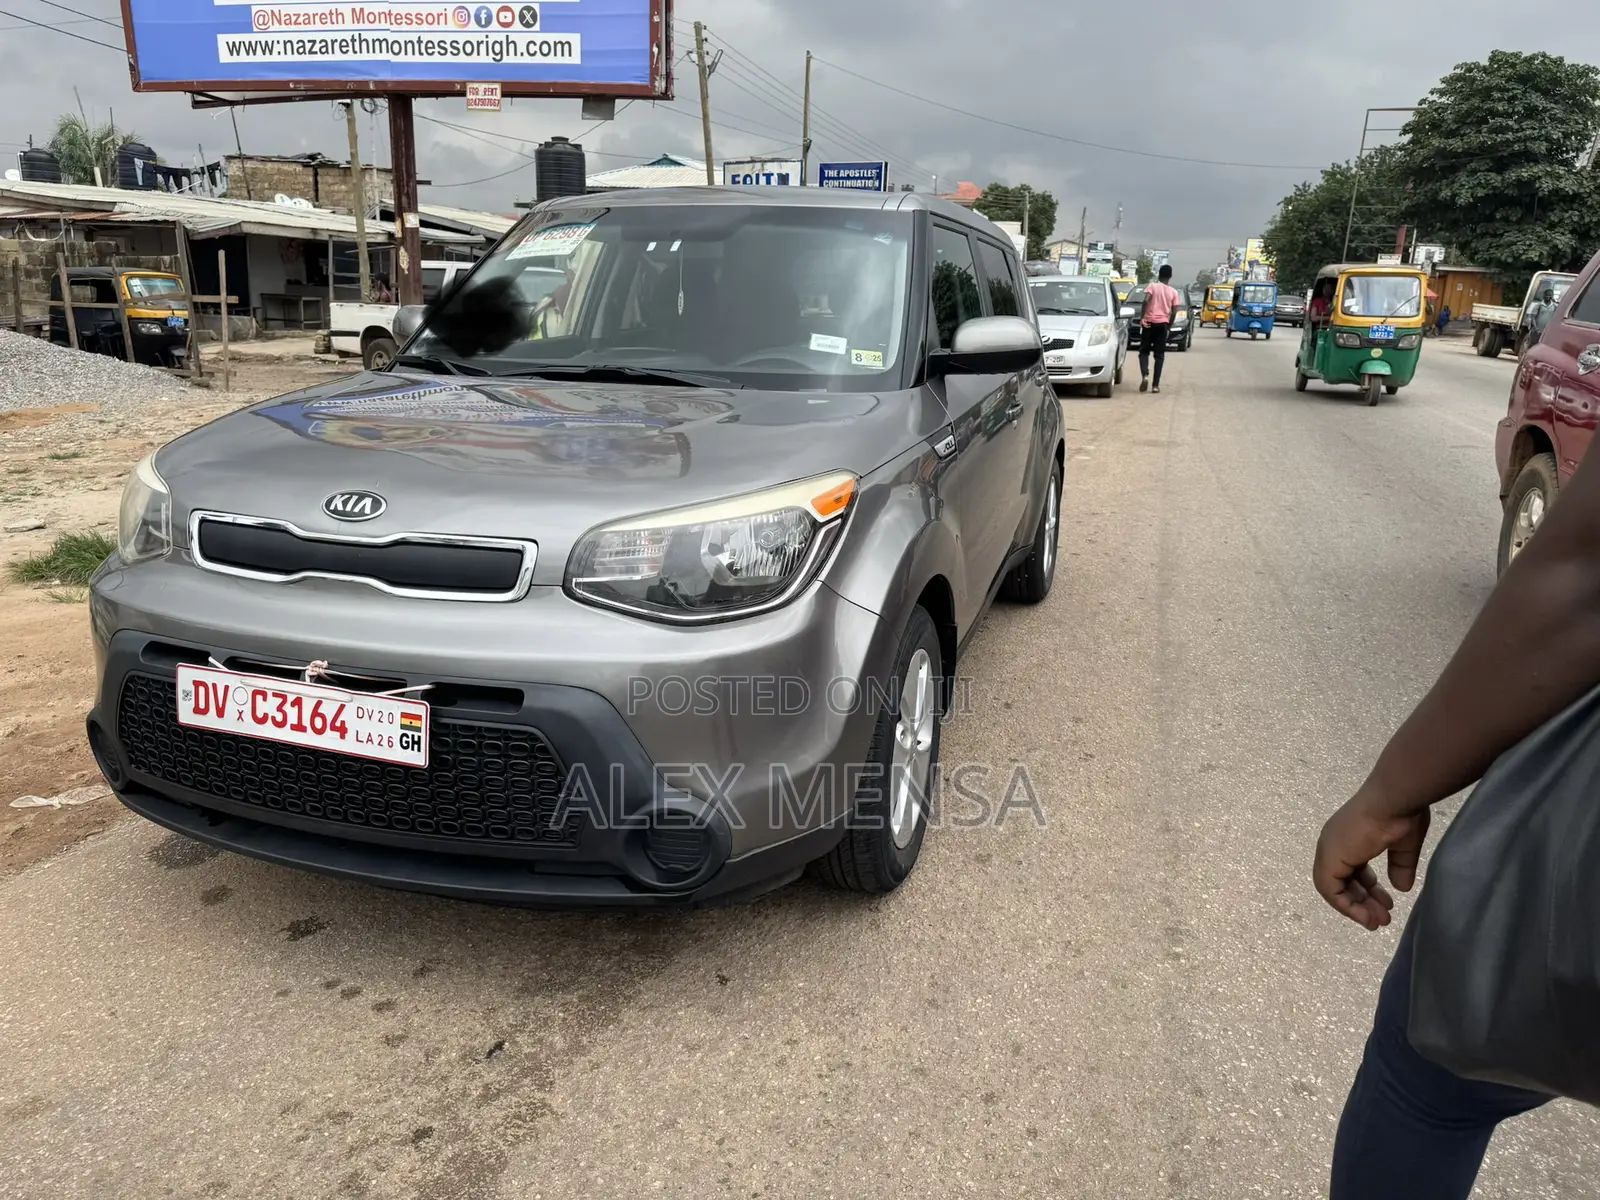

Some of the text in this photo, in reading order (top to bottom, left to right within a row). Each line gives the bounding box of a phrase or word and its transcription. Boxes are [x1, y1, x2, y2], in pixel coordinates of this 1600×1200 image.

[253, 7, 448, 31] @Nazareth Montessori
[225, 33, 572, 62] www:nazarethmontessorigh.com
[484, 87, 498, 96] RENT
[823, 179, 880, 188] CONTINUATION
[824, 169, 839, 178] THE
[855, 353, 863, 362] 8
[329, 494, 373, 514] KIA
[192, 679, 348, 740] DV C3164
[399, 732, 422, 753] GH
